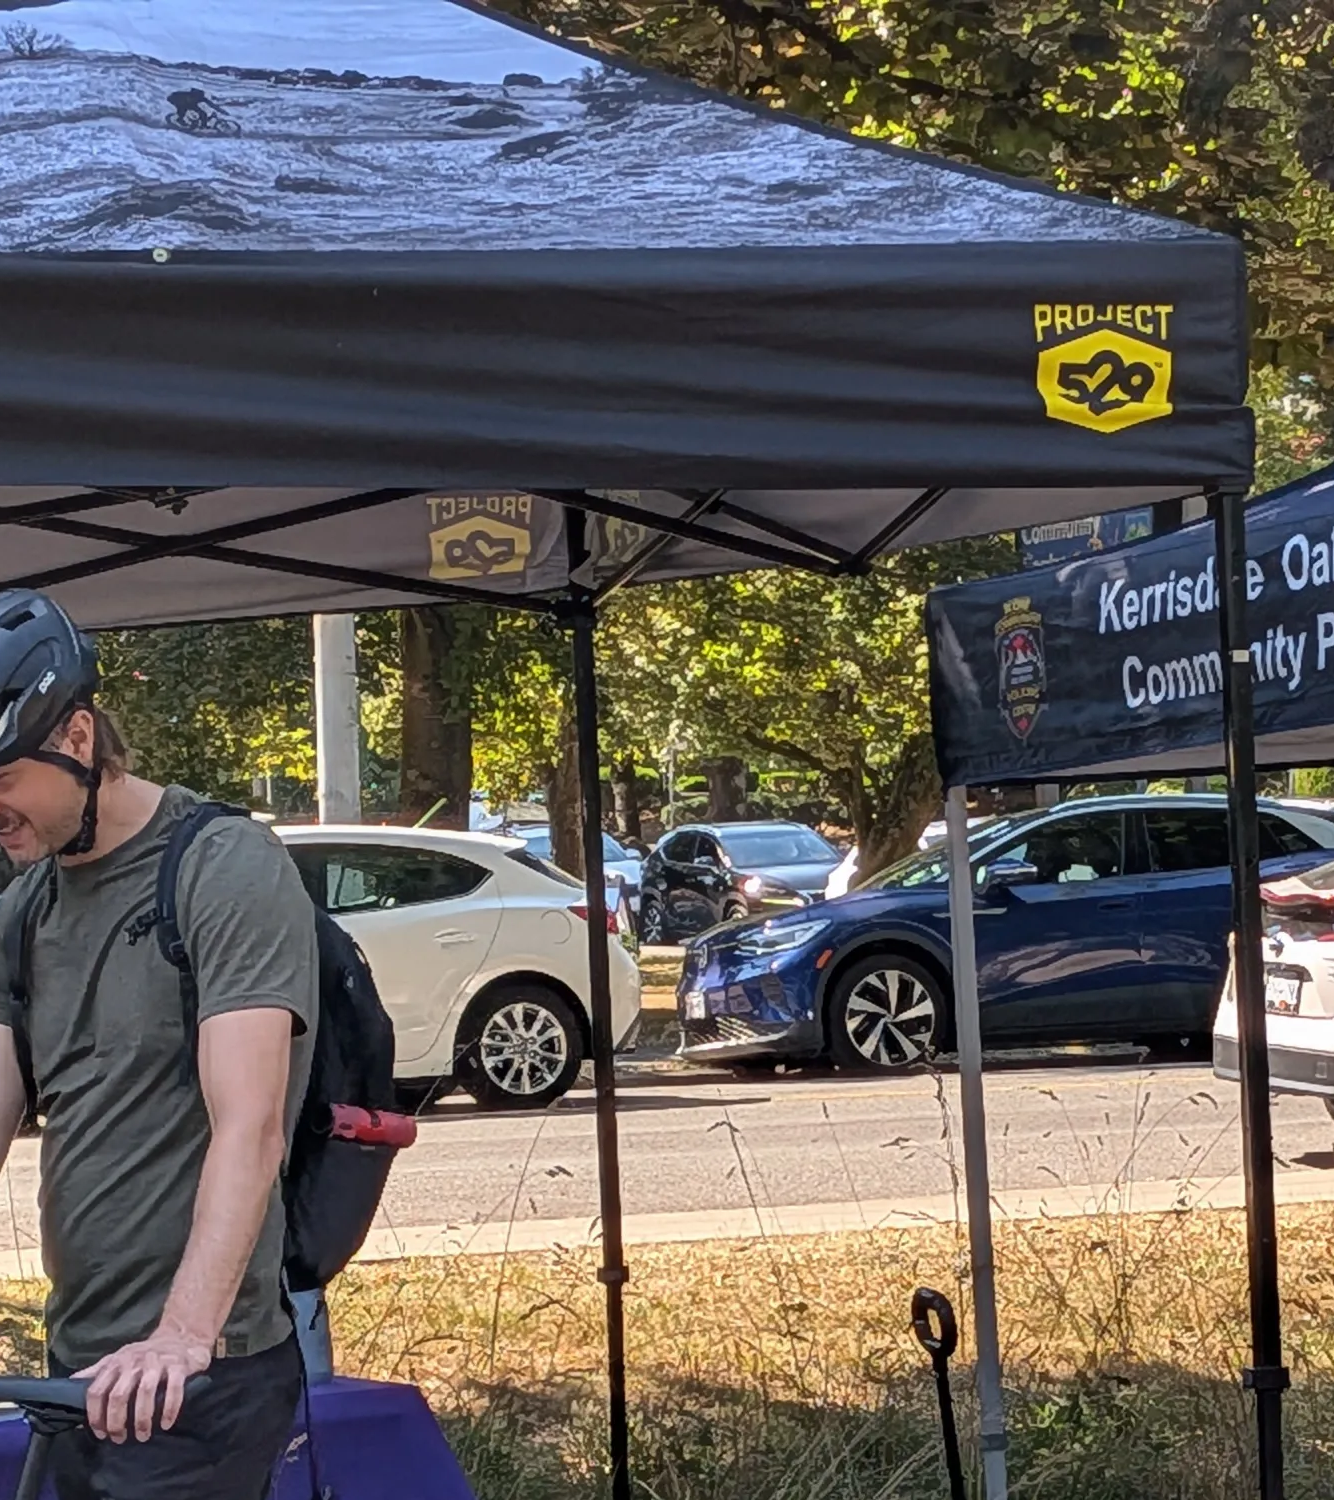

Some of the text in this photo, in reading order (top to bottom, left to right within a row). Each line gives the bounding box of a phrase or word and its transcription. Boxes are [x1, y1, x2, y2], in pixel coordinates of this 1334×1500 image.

[1034, 304, 1174, 342] PROJECT
[1057, 350, 1155, 416] 529
[1099, 555, 1266, 635] Kerrisde
[1122, 624, 1307, 708] Commnity
